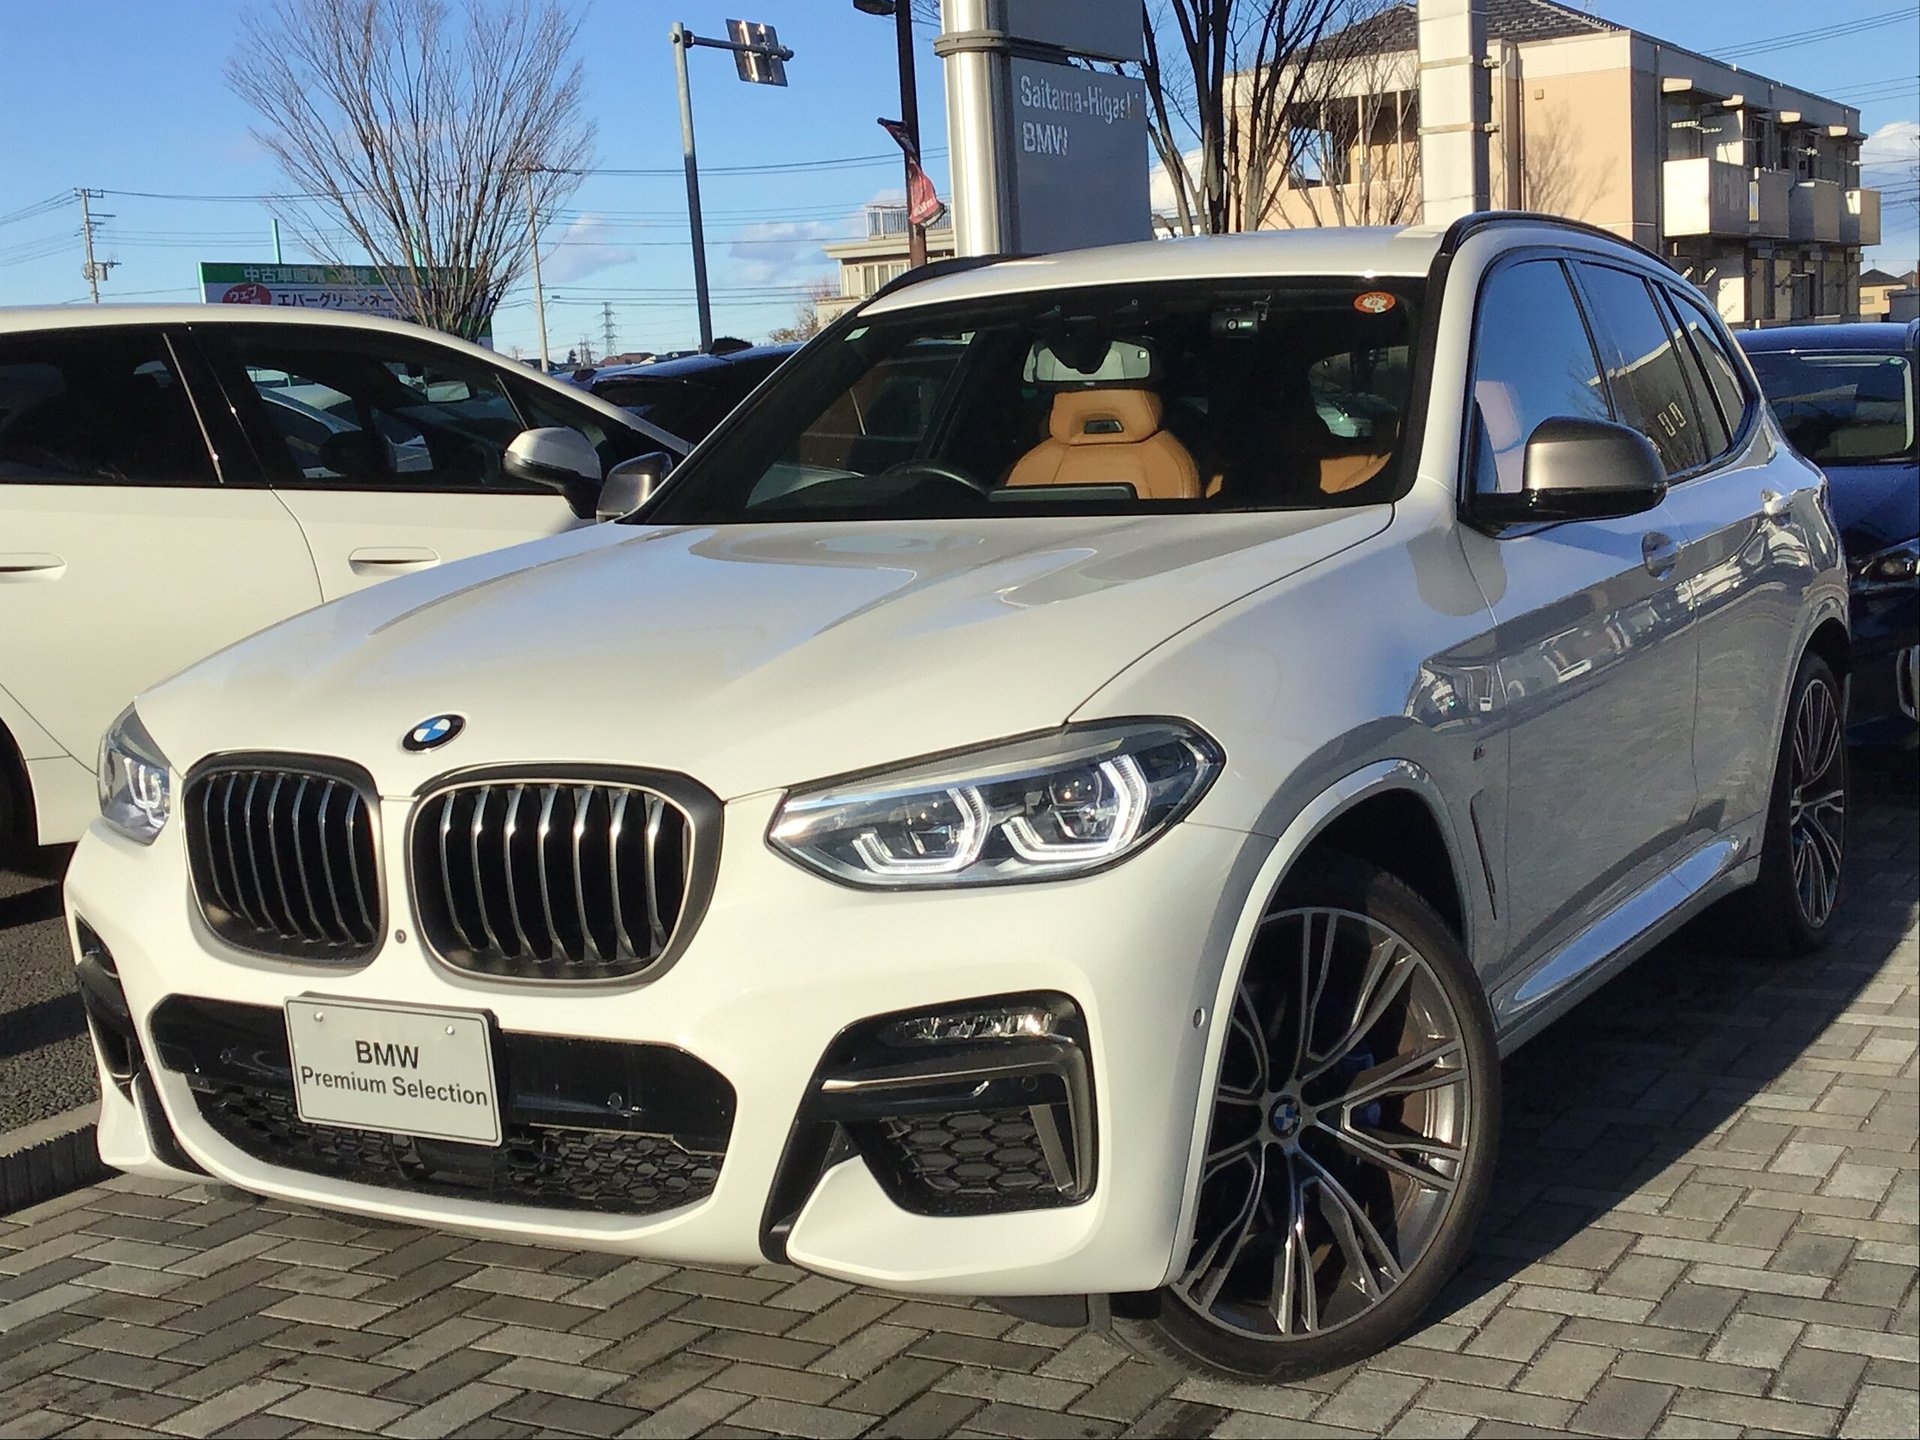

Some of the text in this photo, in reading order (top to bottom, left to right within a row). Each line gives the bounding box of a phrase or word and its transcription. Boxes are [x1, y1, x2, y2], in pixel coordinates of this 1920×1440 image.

[1022, 122, 1068, 155] BMW
[355, 1040, 419, 1070] BMW
[301, 1066, 488, 1106] Premium Selection
